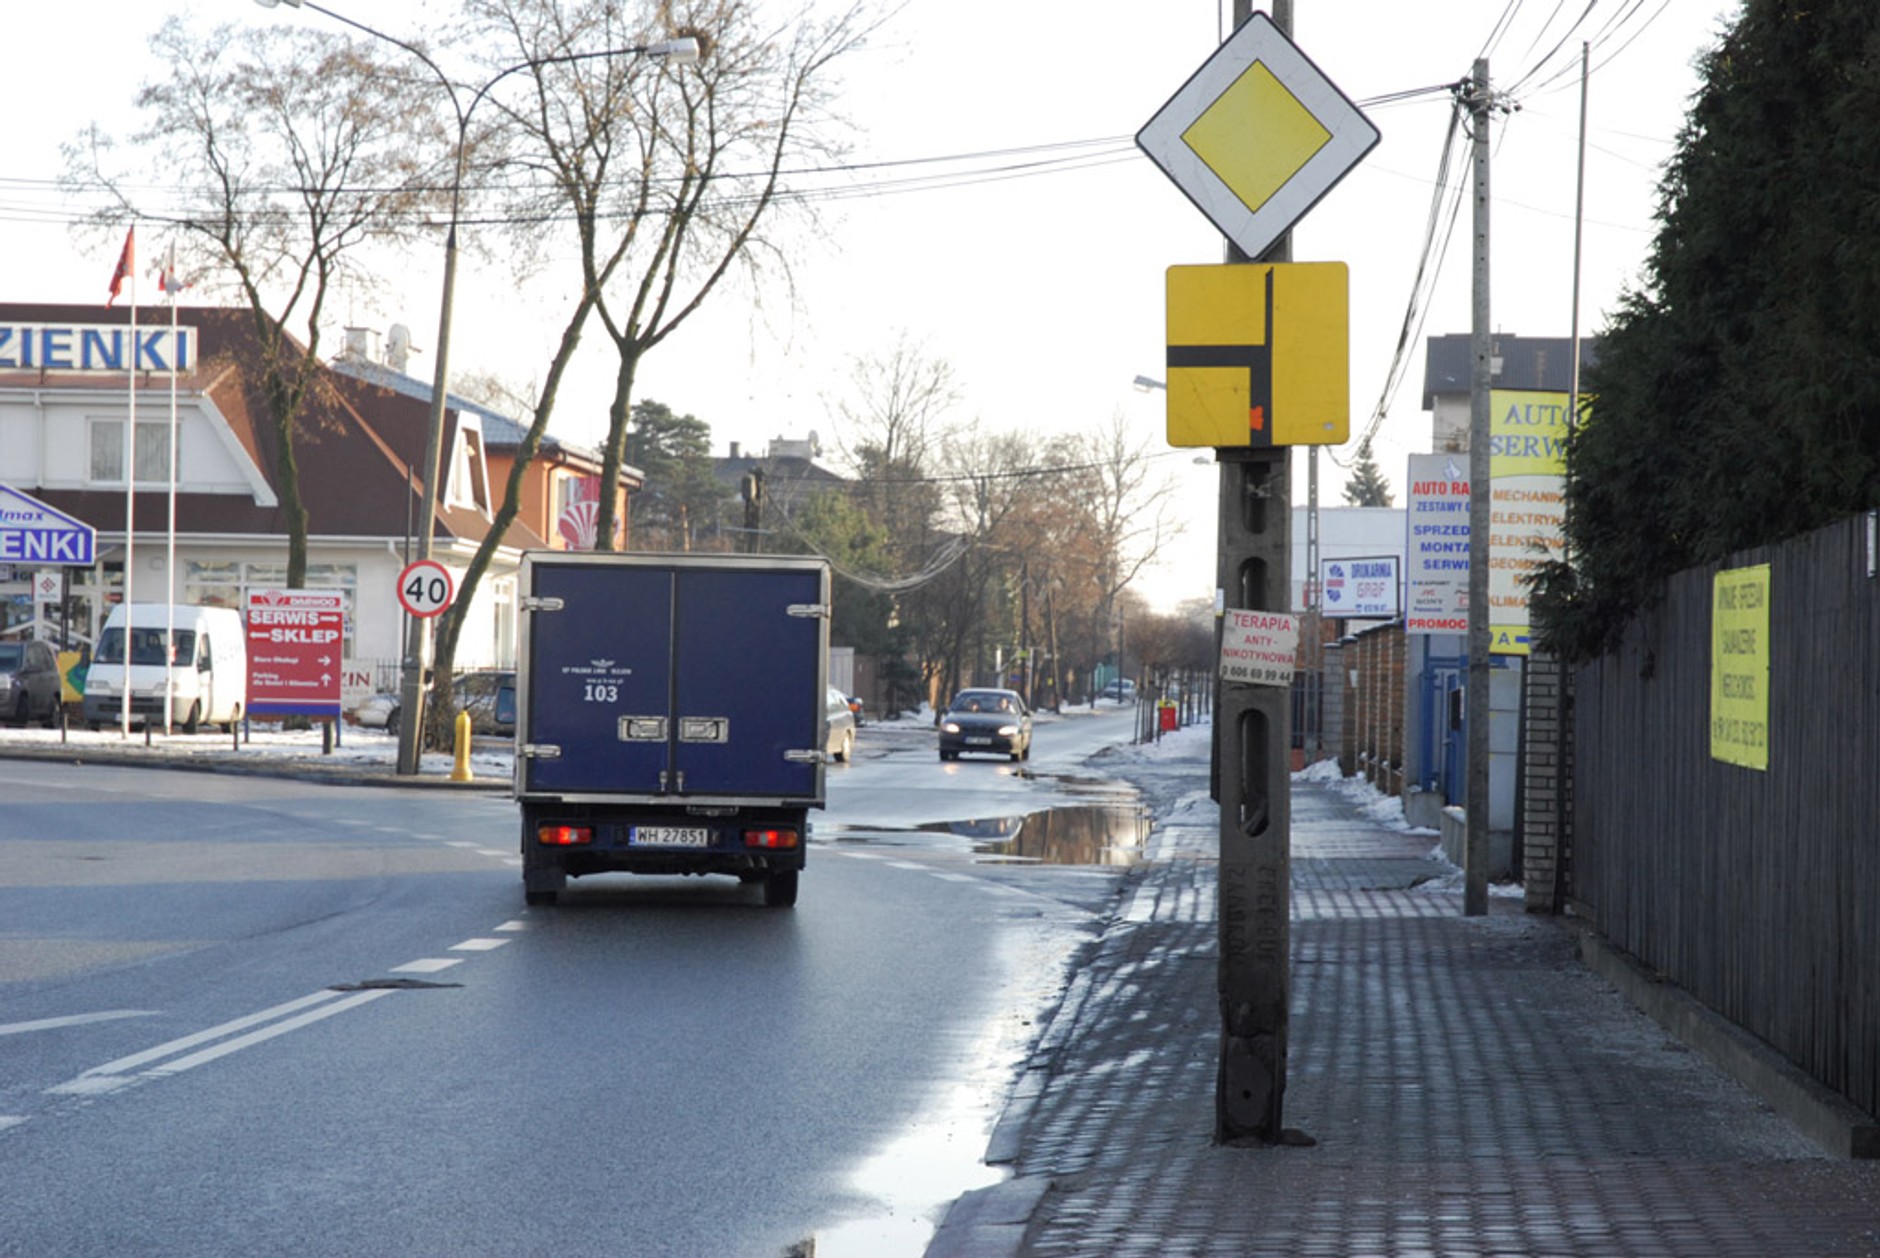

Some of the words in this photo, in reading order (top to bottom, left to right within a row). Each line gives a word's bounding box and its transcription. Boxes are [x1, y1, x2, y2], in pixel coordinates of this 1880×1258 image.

[1504, 403, 1582, 426] AUTO
[1413, 481, 1447, 496] AUTO
[1416, 501, 1461, 512] ZESTAWY
[0, 530, 85, 560] ENKI
[405, 576, 446, 604] 40
[250, 611, 319, 626] SERWIS
[1234, 613, 1291, 632] TERAPIA
[271, 628, 339, 643] SKLEP
[1222, 648, 1294, 664] NIKOTYNOWA
[1279, 671, 1291, 681] 44
[584, 684, 618, 702] 103
[638, 829, 658, 842] WH
[663, 829, 704, 843] 27851
